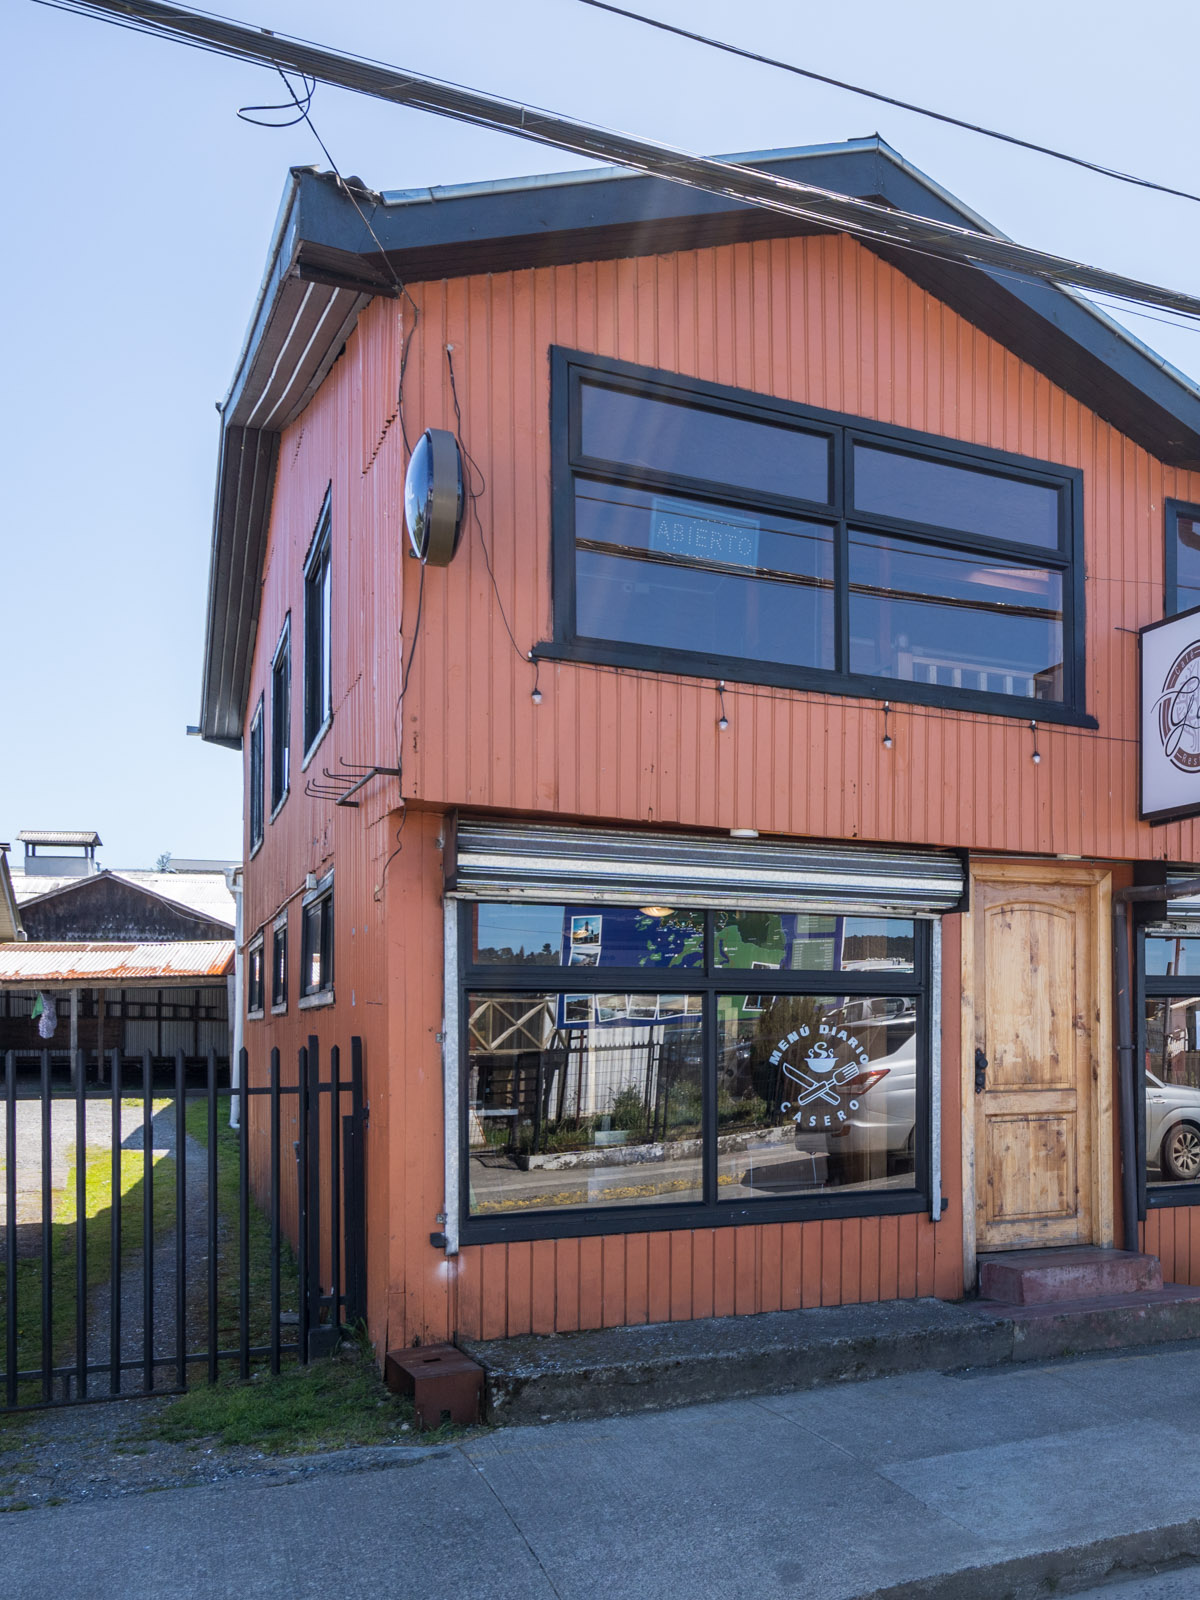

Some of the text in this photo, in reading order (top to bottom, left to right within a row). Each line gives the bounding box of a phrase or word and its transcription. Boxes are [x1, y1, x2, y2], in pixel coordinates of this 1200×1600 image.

[656, 521, 752, 556] ABIERTO
[1174, 649, 1195, 675] Café
[769, 1024, 869, 1066] MENÚ DIARIO
[781, 1100, 859, 1126] CASERO
